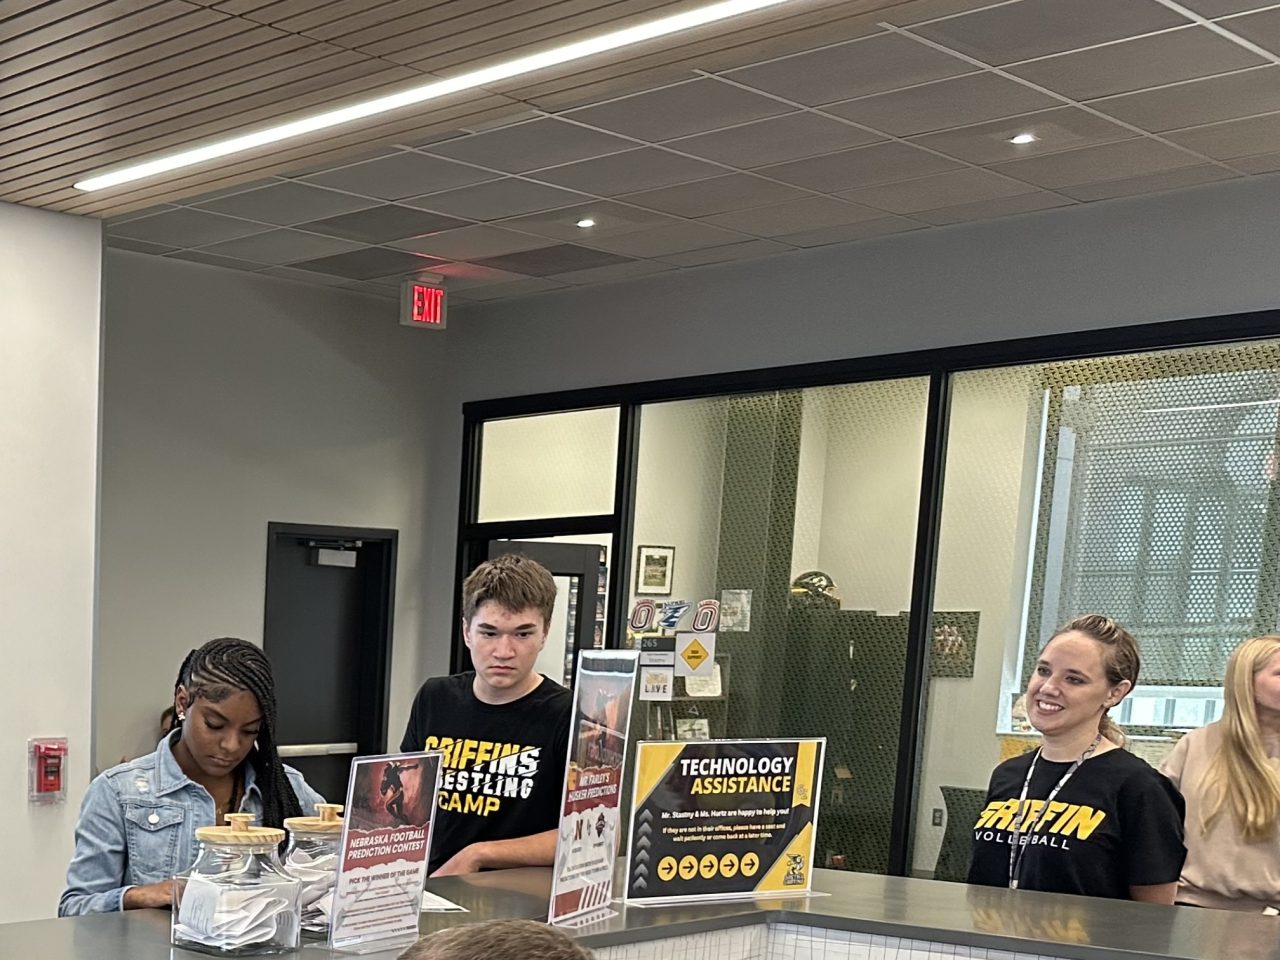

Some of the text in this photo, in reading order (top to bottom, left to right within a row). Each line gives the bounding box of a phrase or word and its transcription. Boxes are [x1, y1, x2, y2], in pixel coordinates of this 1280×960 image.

[413, 285, 443, 324] EXIT
[642, 640, 658, 648] 265
[424, 736, 542, 777] GRIFFINS
[680, 757, 794, 776] TECHNOLOGY
[690, 775, 791, 795] ASSISTANCE
[438, 791, 500, 817] CAMP
[738, 808, 755, 818] happy
[763, 808, 776, 817] help
[973, 798, 1106, 840] GRIFFIN
[350, 829, 424, 849] NEBRASKA FOOTBALL
[347, 840, 424, 860] PREDICTION CONTEST
